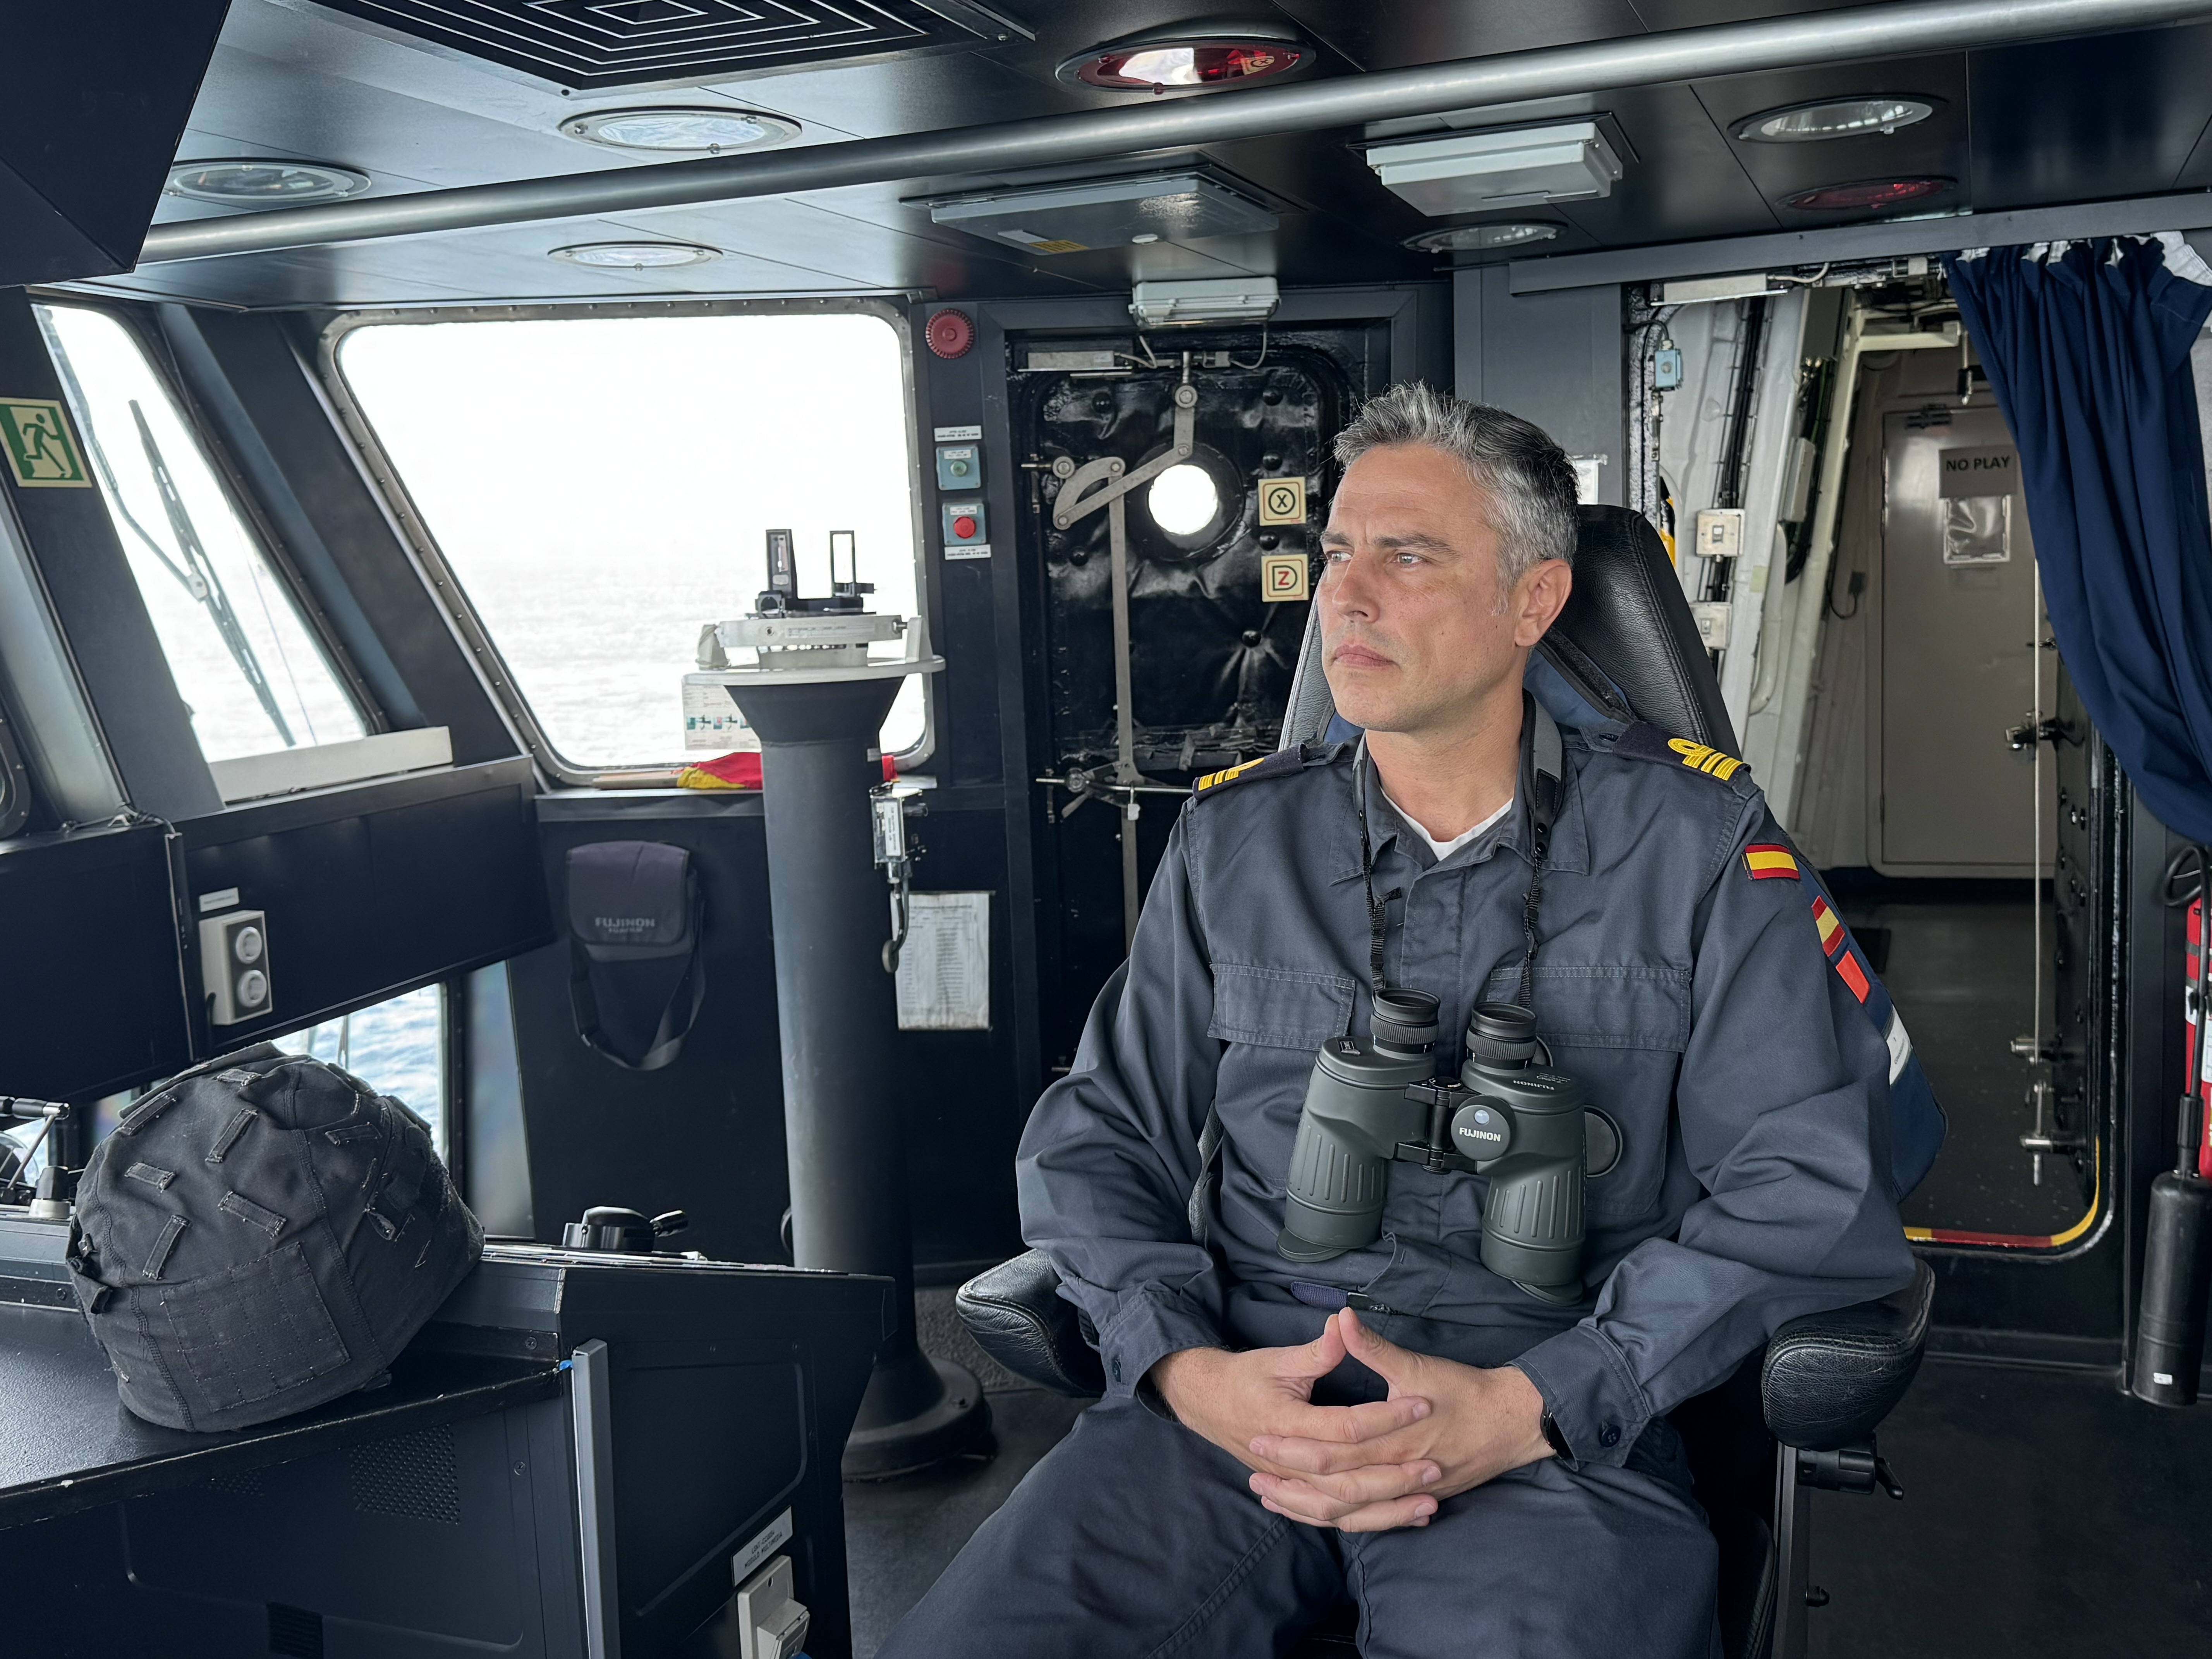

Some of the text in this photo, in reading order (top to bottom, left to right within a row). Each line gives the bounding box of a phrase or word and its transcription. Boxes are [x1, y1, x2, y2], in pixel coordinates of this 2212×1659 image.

[1946, 455, 2010, 471] NO PLAY
[1276, 494, 1288, 508] X
[1278, 571, 1290, 586] Z
[595, 917, 655, 927] FUJINON
[1513, 1080, 1554, 1090] FUJINON
[1459, 1127, 1501, 1142] FUJINON
